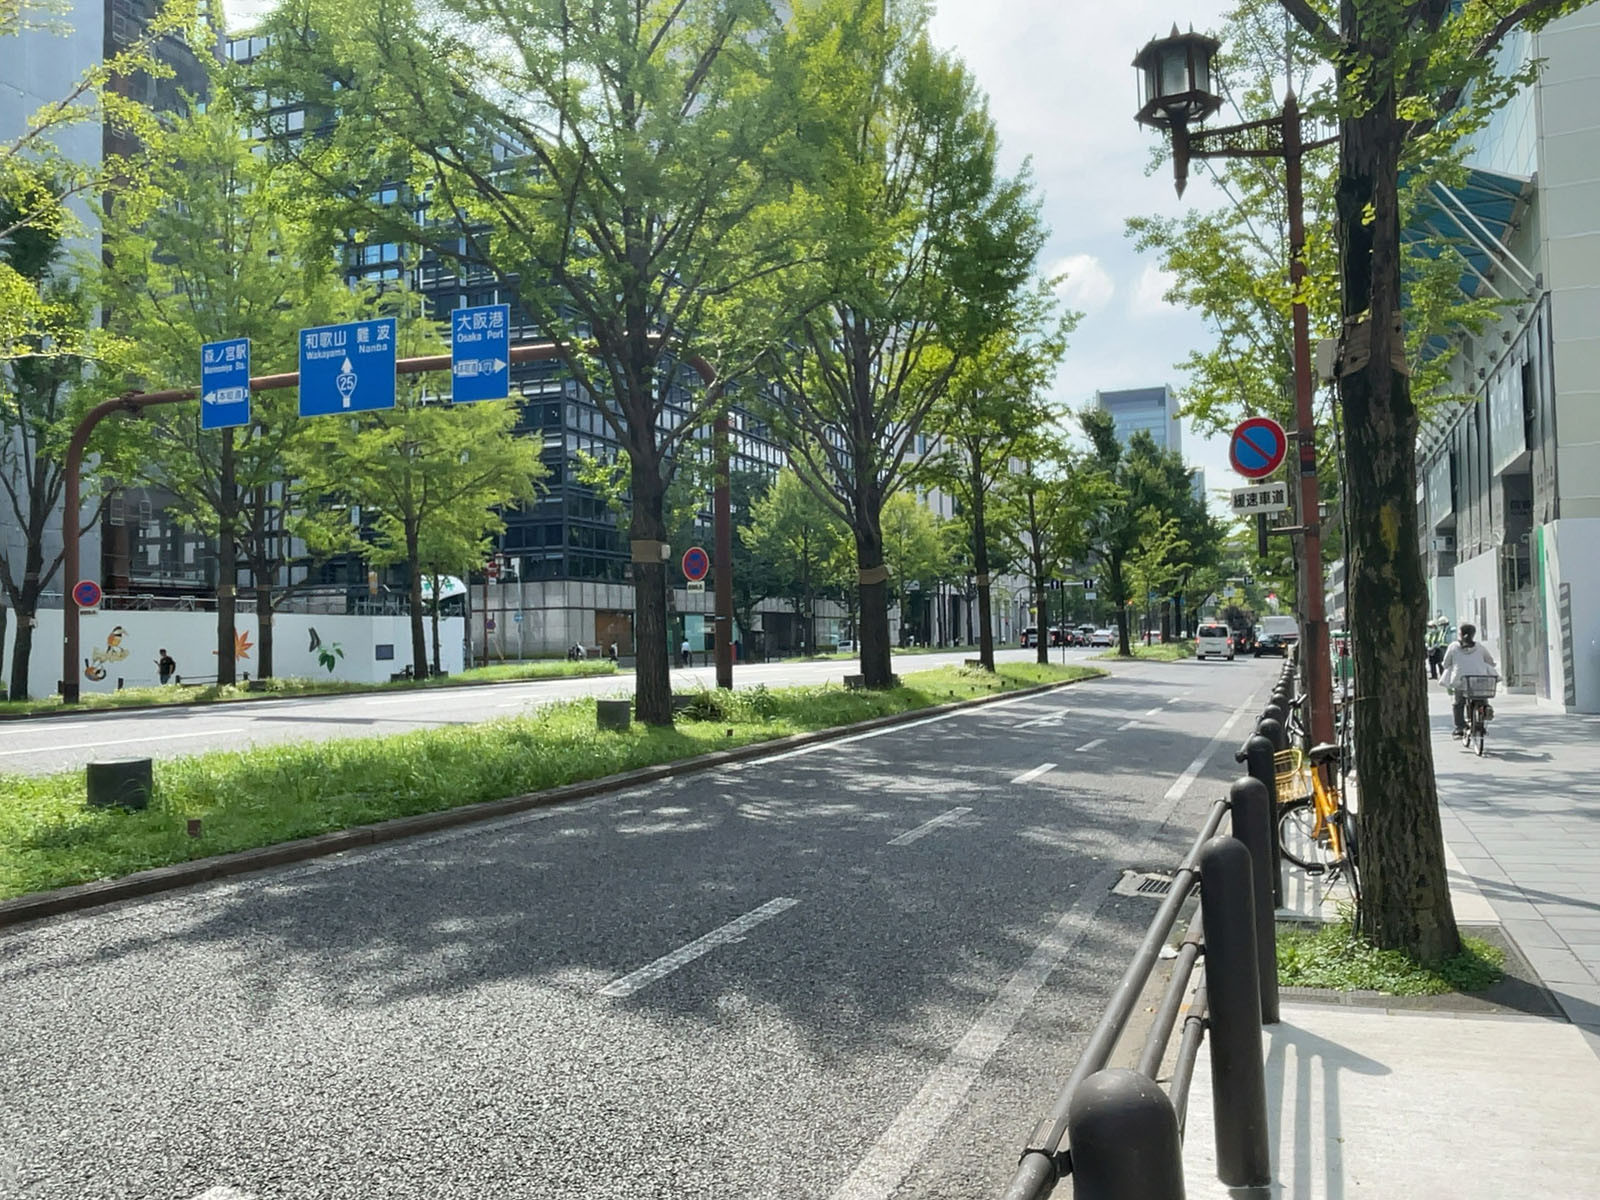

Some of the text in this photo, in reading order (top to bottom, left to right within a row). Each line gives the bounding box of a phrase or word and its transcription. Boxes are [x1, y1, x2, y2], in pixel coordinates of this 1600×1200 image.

[457, 311, 504, 331] 大阪港
[304, 330, 347, 349] 和歌山
[487, 329, 504, 340] Port
[340, 376, 354, 390] 25
[1233, 489, 1285, 508] 緩速車道
